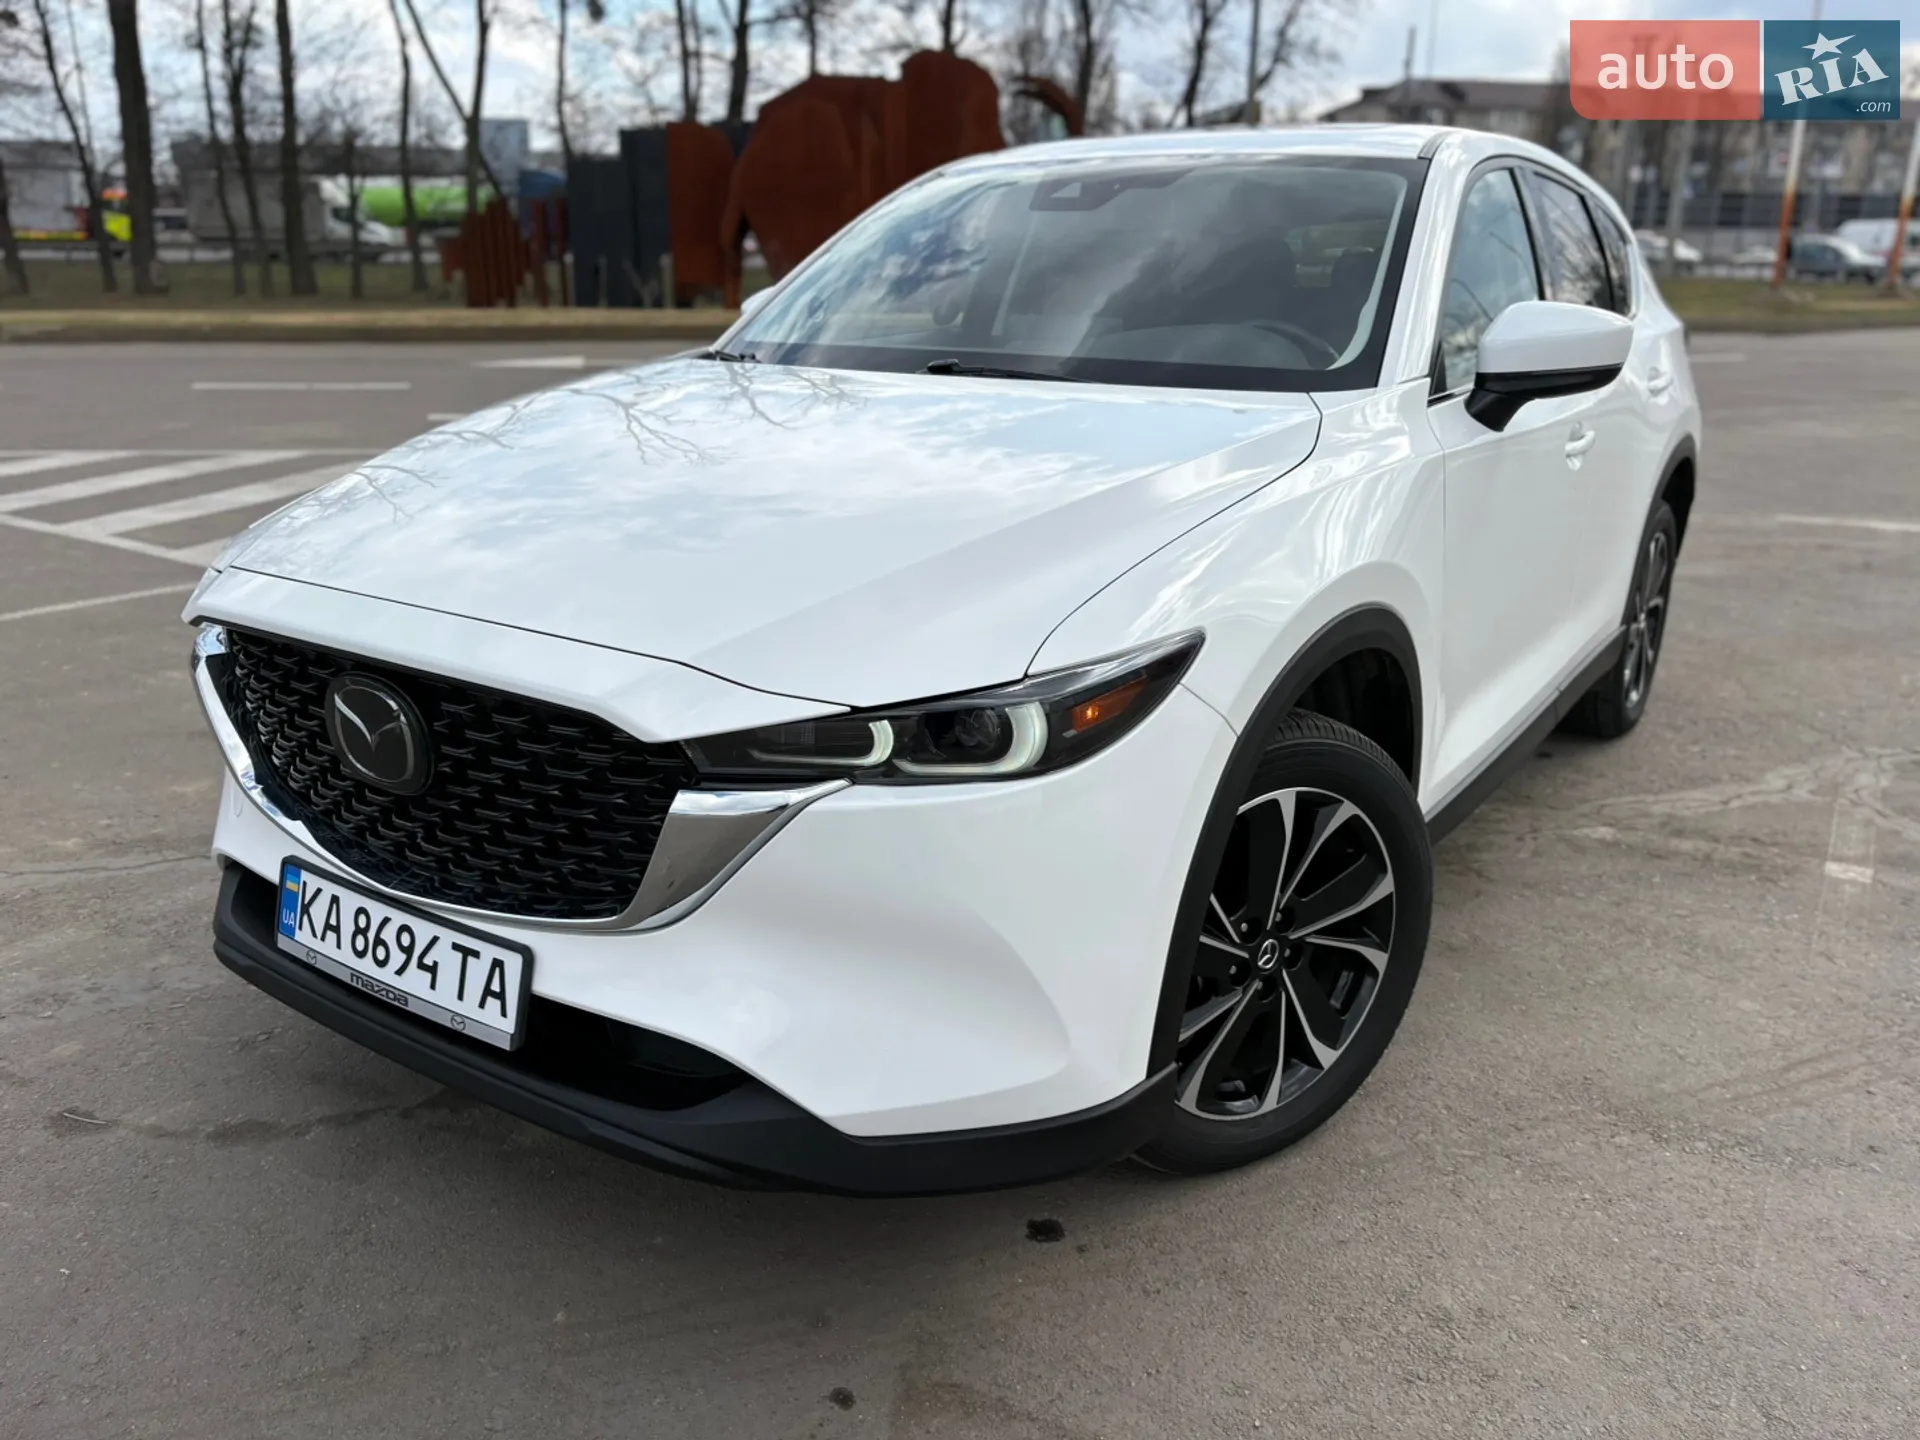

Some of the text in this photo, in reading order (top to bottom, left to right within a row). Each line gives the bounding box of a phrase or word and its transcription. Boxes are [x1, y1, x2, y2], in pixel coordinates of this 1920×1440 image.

[282, 907, 296, 928] UA
[298, 880, 508, 1019] KA 8694 TA
